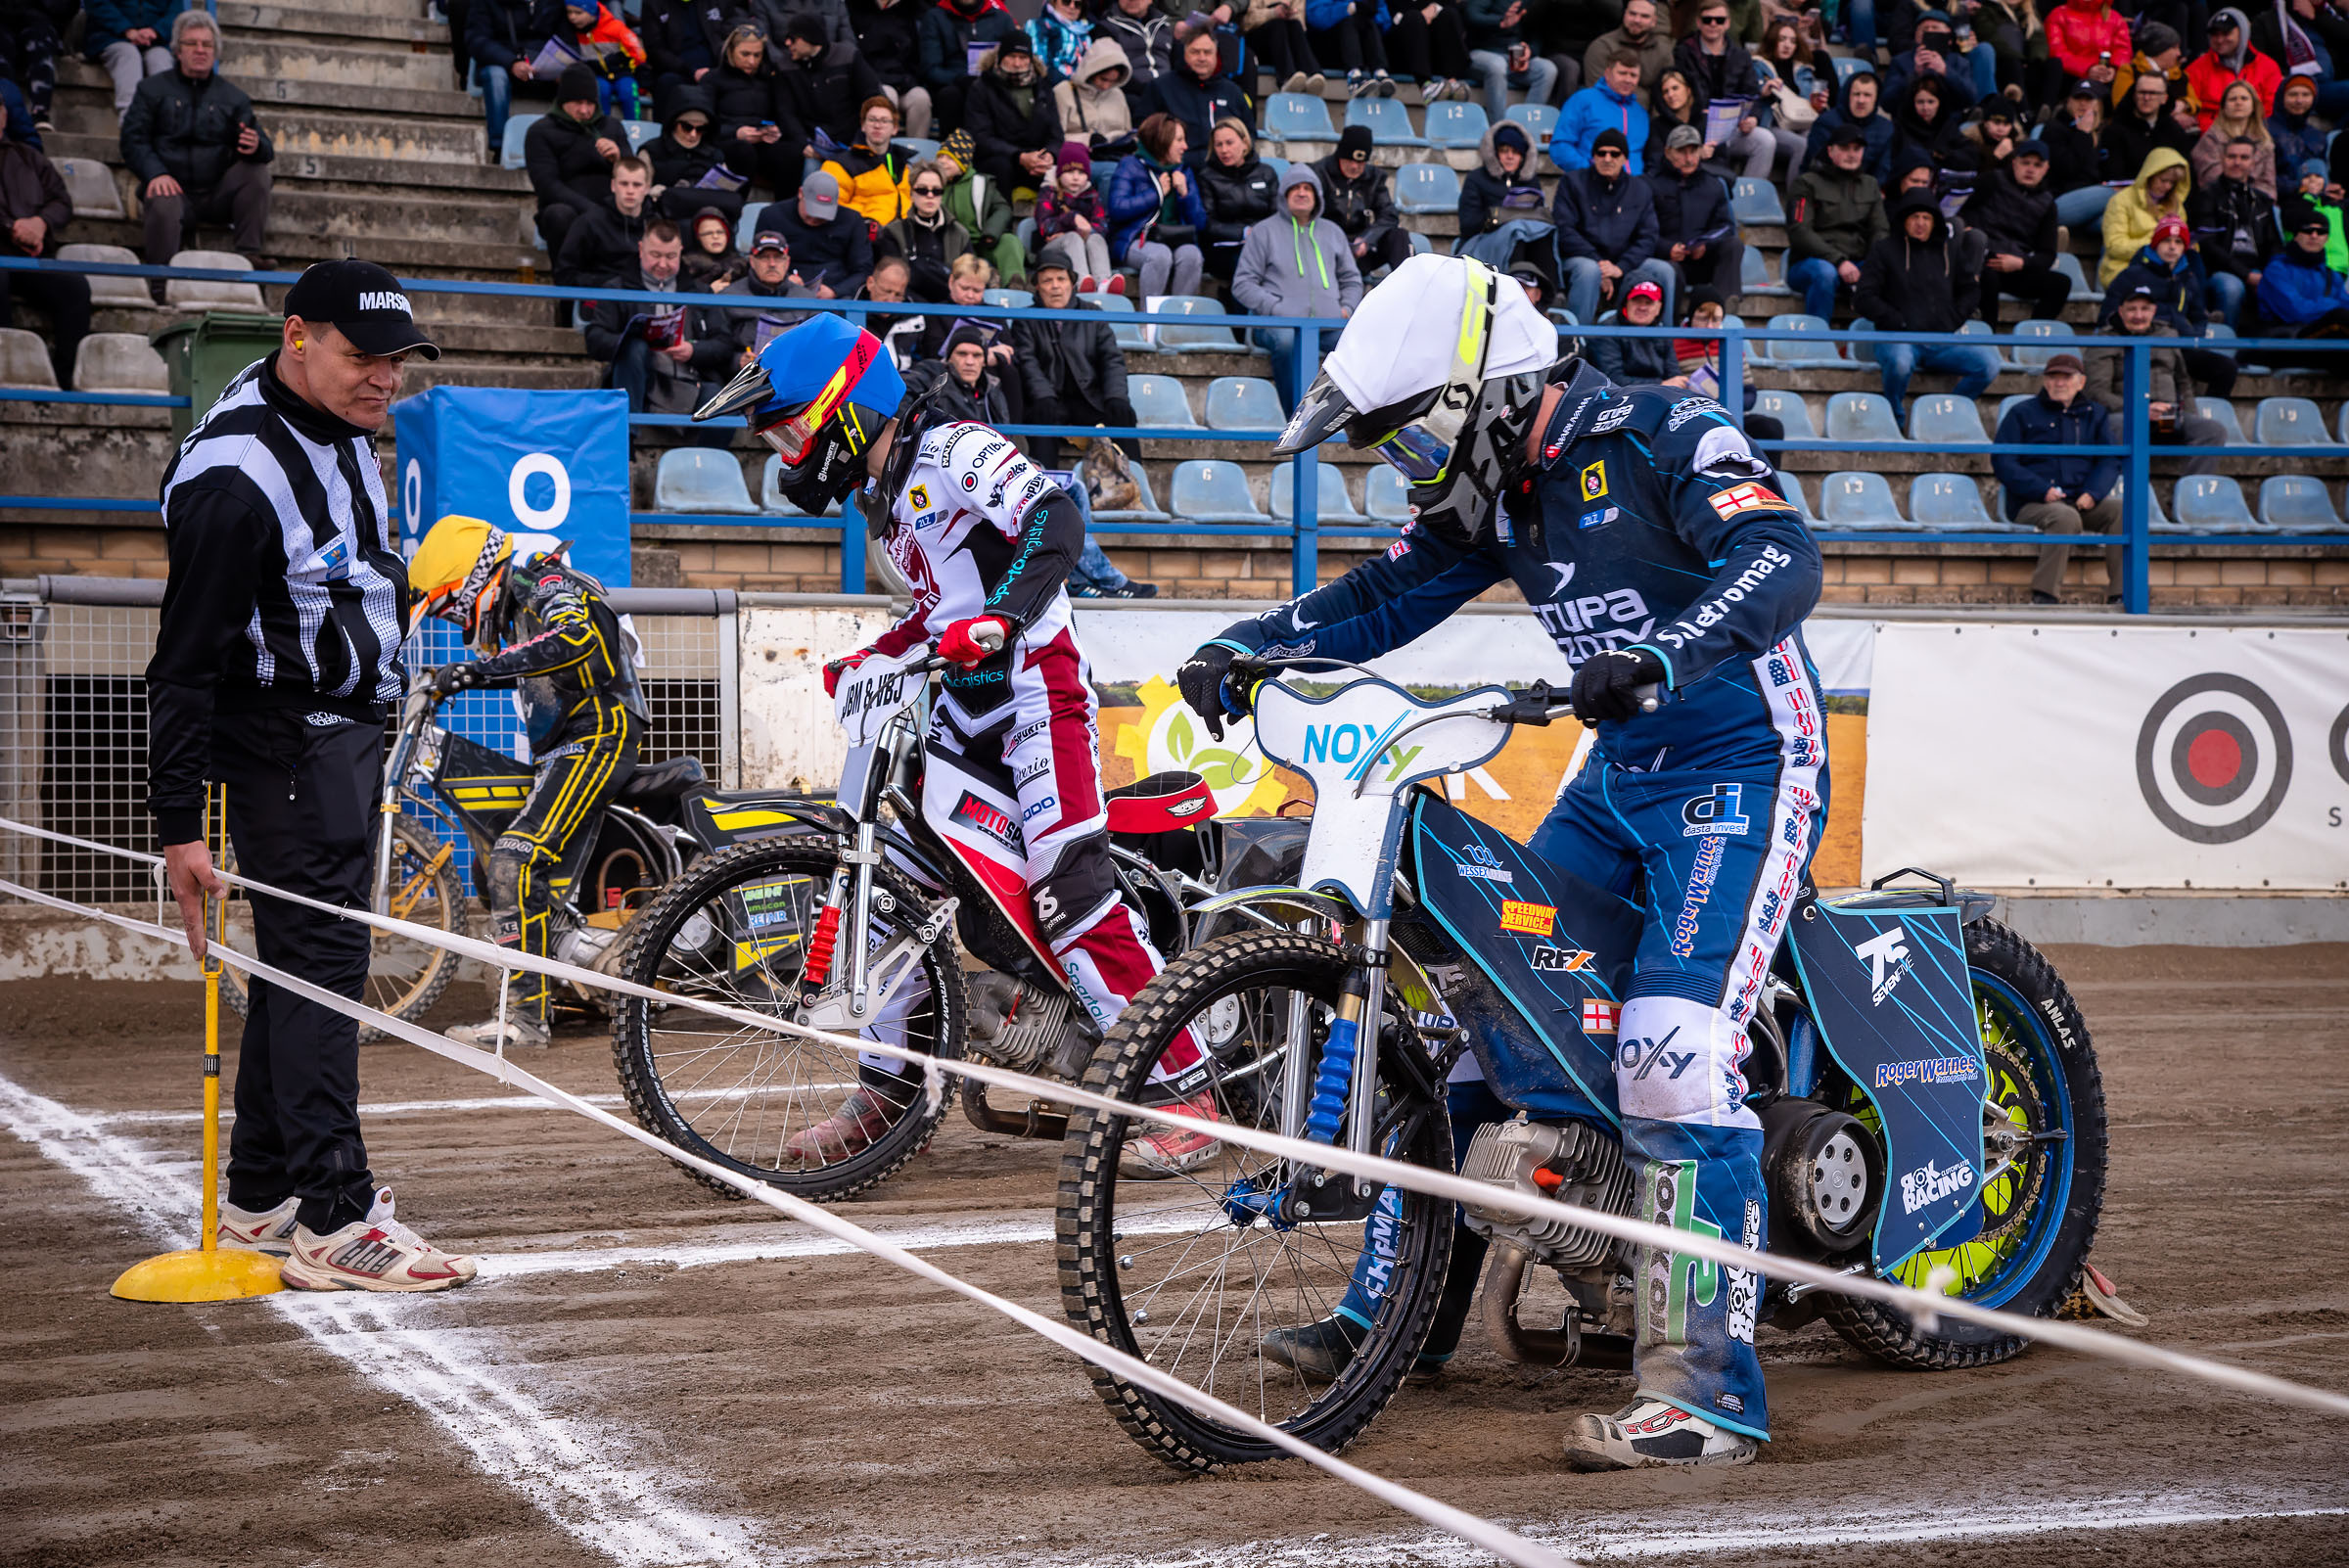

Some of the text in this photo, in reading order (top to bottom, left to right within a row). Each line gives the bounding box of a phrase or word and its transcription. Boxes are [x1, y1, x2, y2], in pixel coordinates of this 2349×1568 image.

[1448, 106, 1464, 119] 12
[306, 158, 316, 175] 5
[1143, 383, 1152, 395] 6
[1235, 384, 1245, 397] 7
[823, 441, 836, 474] Husqvarna
[1203, 468, 1212, 481] 6
[1844, 480, 1864, 494] 13
[2197, 480, 2218, 497] 17
[960, 796, 1028, 845] MOTOSP
[2328, 807, 2342, 828] S
[1714, 822, 1746, 833] invest
[1503, 900, 1557, 920] SPEEDWAY
[1502, 911, 1546, 930] SERVICE
[2040, 997, 2077, 1050] ANLAS
[1903, 1167, 1973, 1215] RACING
